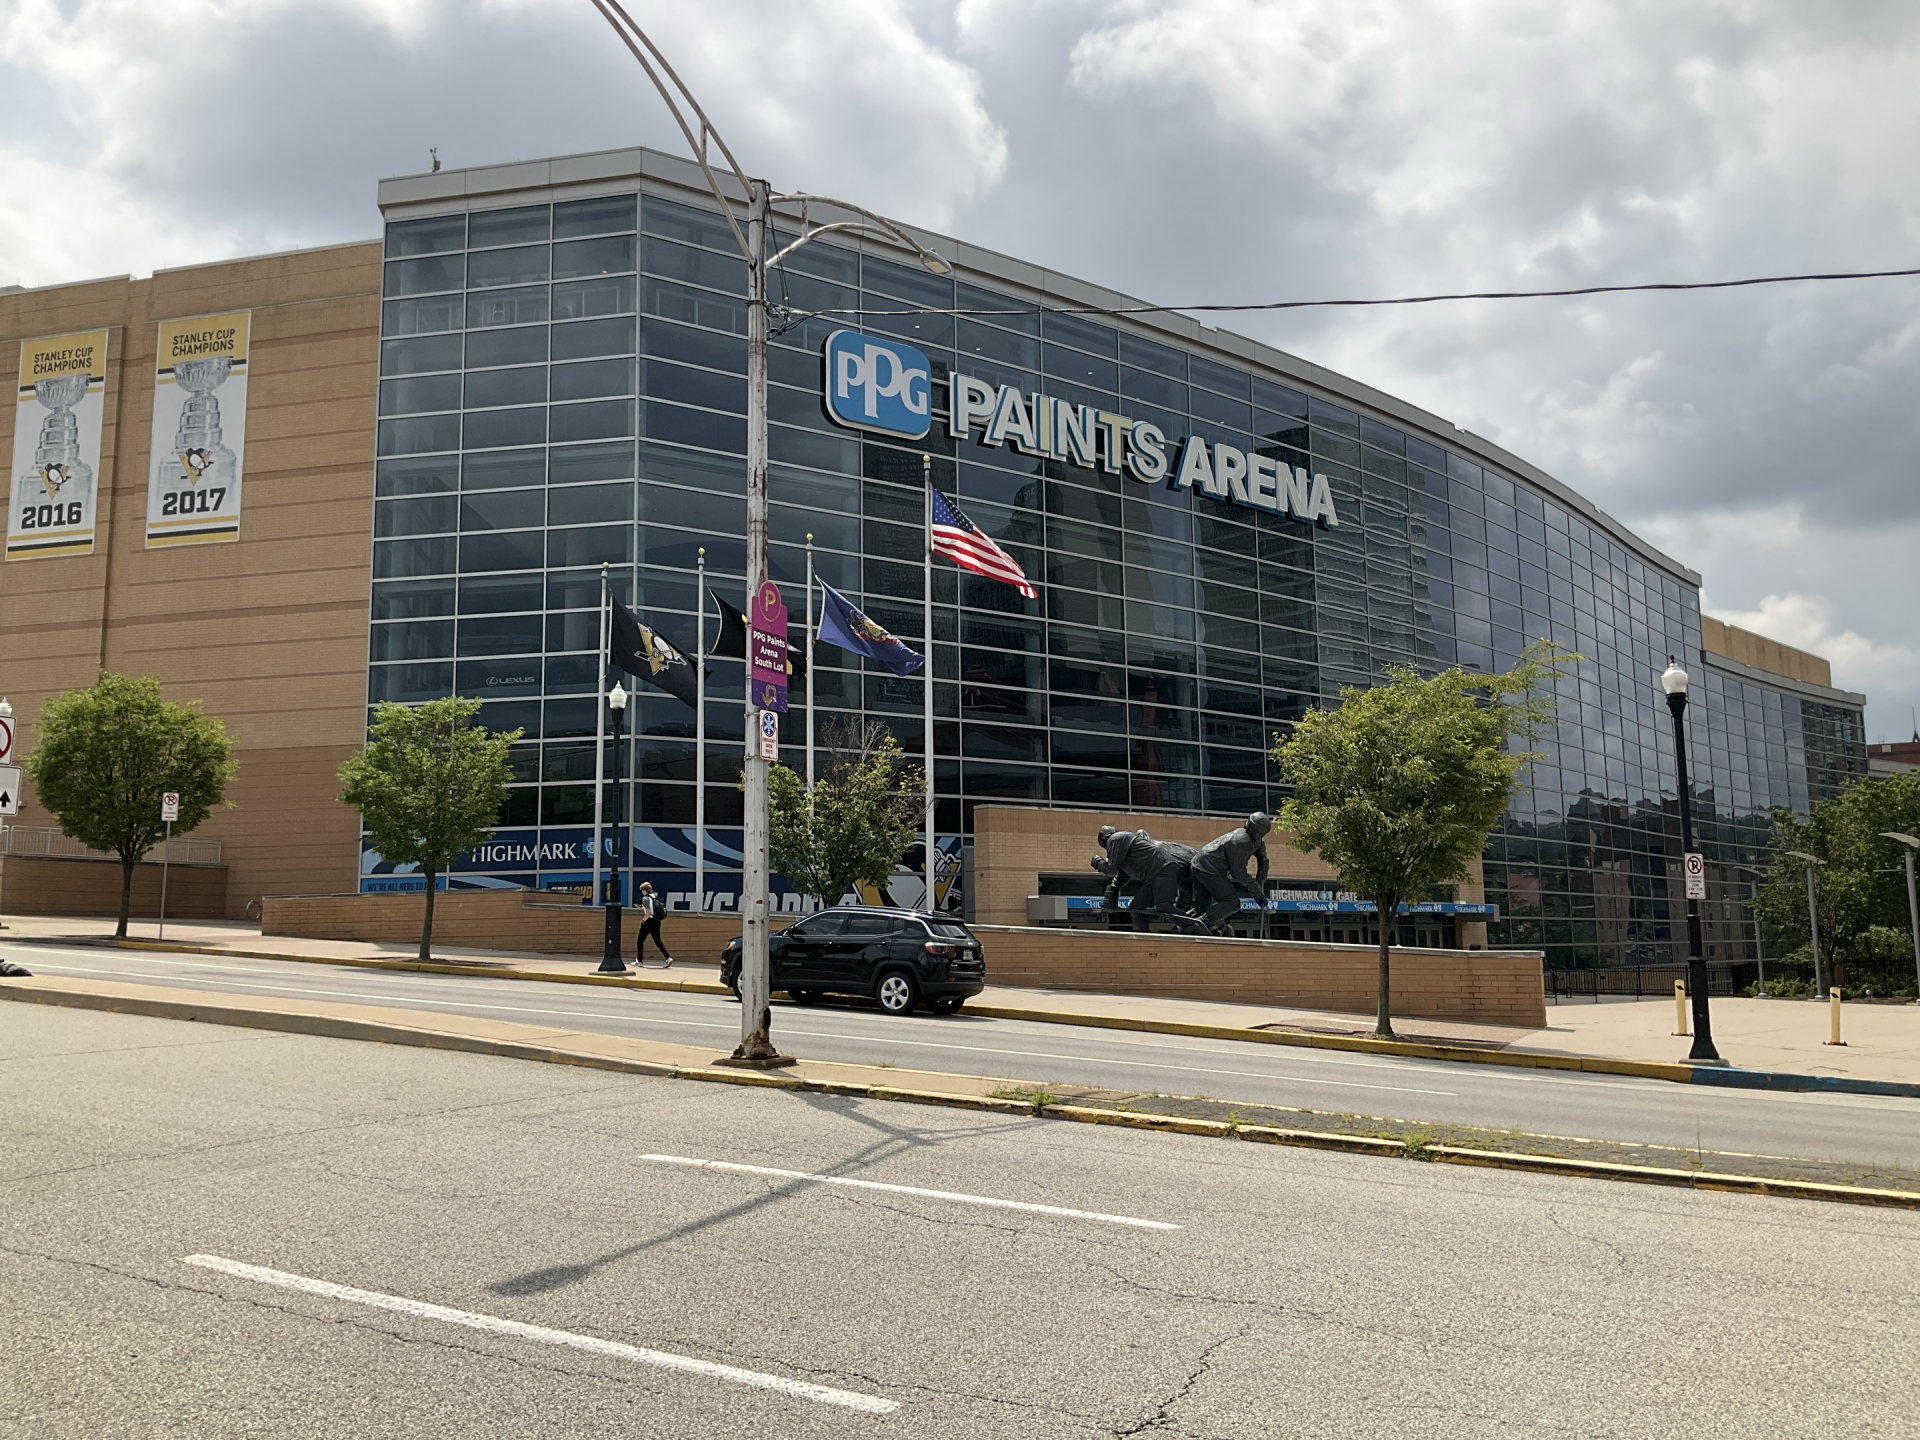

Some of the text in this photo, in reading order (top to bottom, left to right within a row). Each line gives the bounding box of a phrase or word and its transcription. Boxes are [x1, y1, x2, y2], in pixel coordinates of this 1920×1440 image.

[173, 328, 236, 345] STANLEY CUP
[33, 346, 93, 364] STANLEY CUP
[172, 339, 234, 357] CHAMPIONS
[33, 357, 92, 375] CHAMPIONS
[837, 343, 1339, 529] PPG PAINTS ARENA
[162, 487, 226, 516] 2017
[21, 502, 82, 529] 2016
[753, 630, 785, 648] PPG Paints
[760, 645, 778, 658] Arena
[754, 656, 784, 672] South Lot
[499, 676, 534, 684] LEXUS
[471, 843, 577, 862] HIGHMARK
[388, 882, 398, 891] ALL
[400, 882, 415, 891] HERE
[415, 882, 424, 891] TO
[1270, 890, 1358, 902] HIGHMARK GATE
